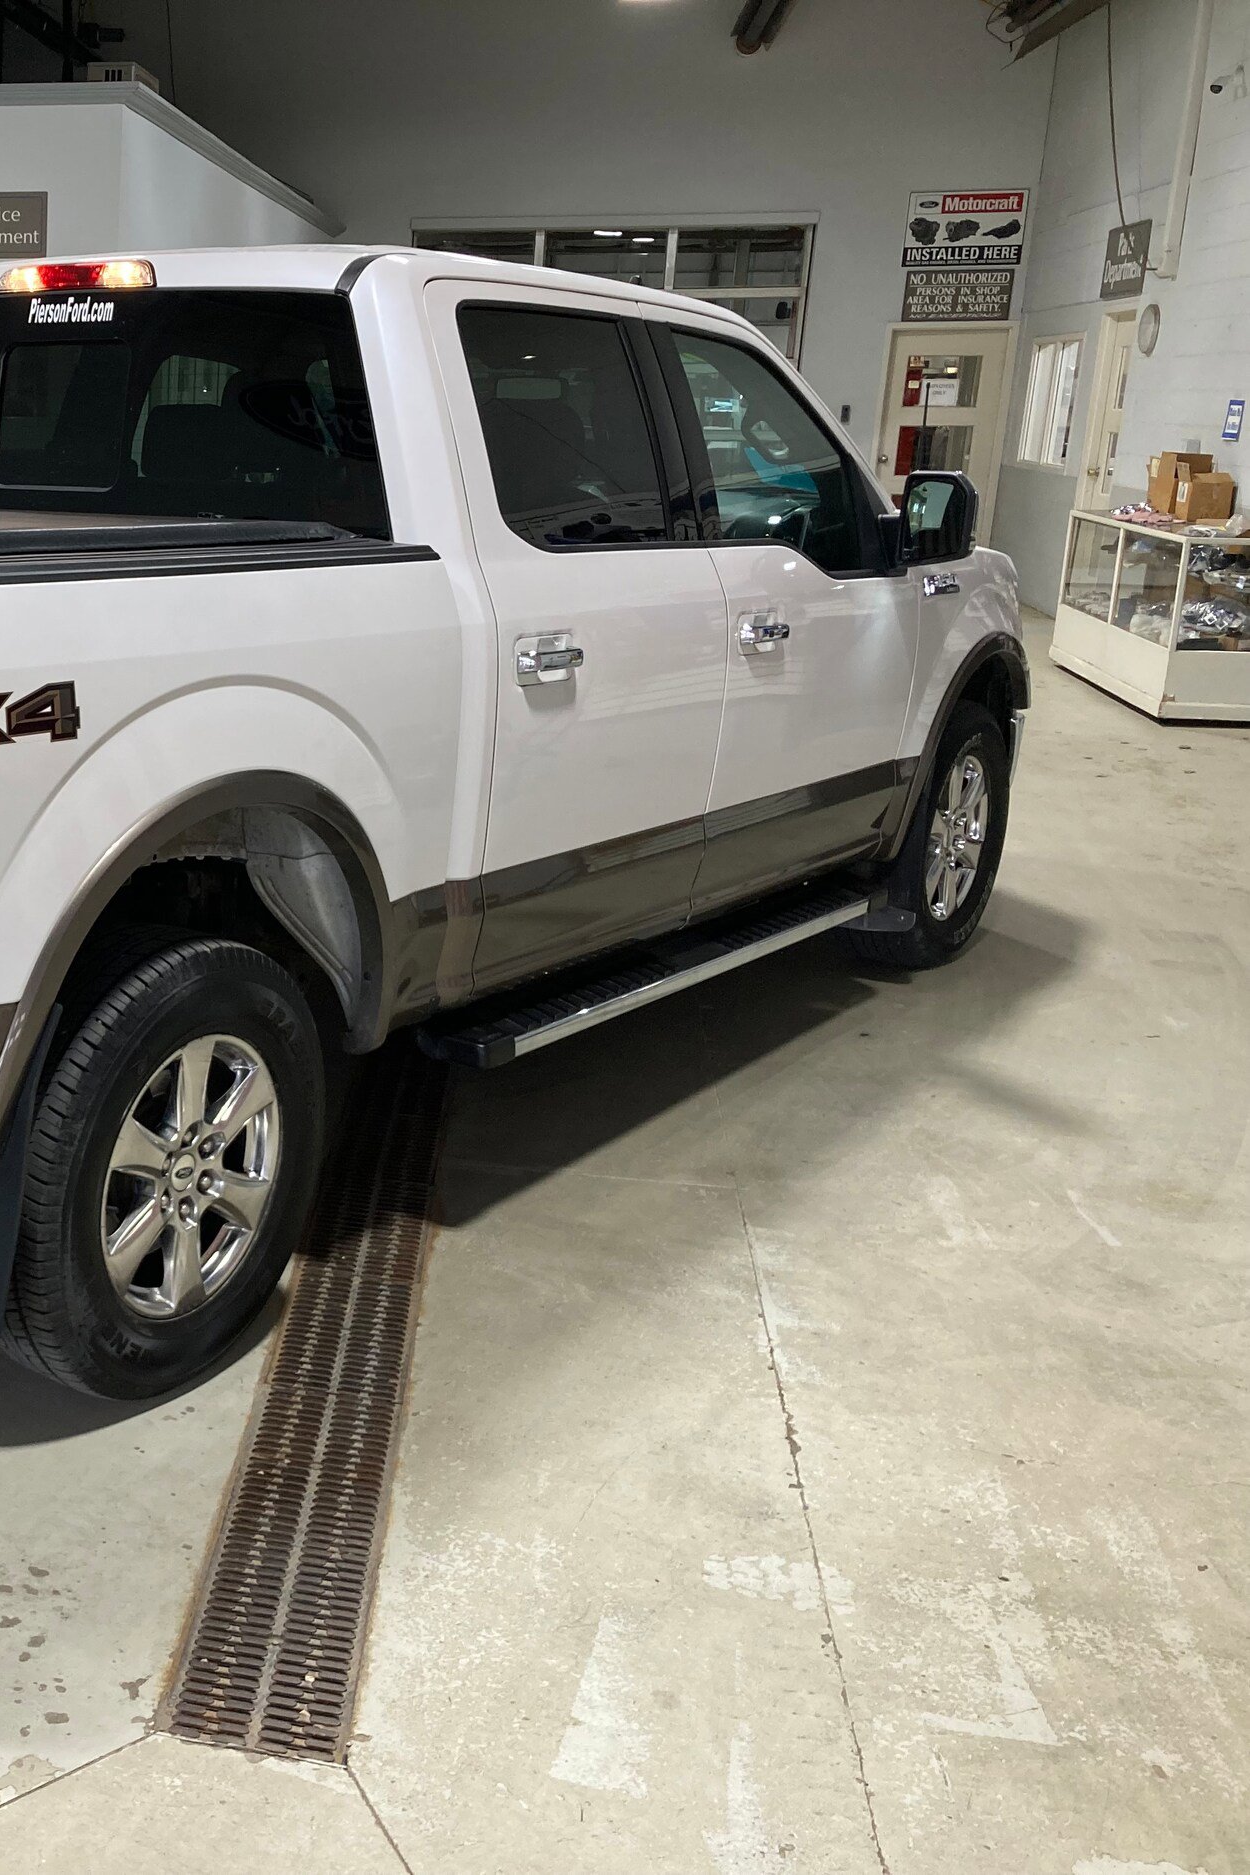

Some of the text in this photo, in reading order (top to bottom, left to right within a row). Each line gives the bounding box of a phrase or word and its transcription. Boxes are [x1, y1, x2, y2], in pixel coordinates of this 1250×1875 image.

[945, 196, 1020, 211] Motorcraft
[907, 246, 1019, 260] INSTALLED HERE
[910, 272, 1010, 284] NO UNAUTHORIZED
[916, 286, 1000, 295] PERSONS IN SHOP
[906, 294, 1009, 304] AREA FOR INSURANCE
[28, 296, 115, 323] PiersonFord.com
[911, 303, 1001, 313] REASONS & SAFETY.
